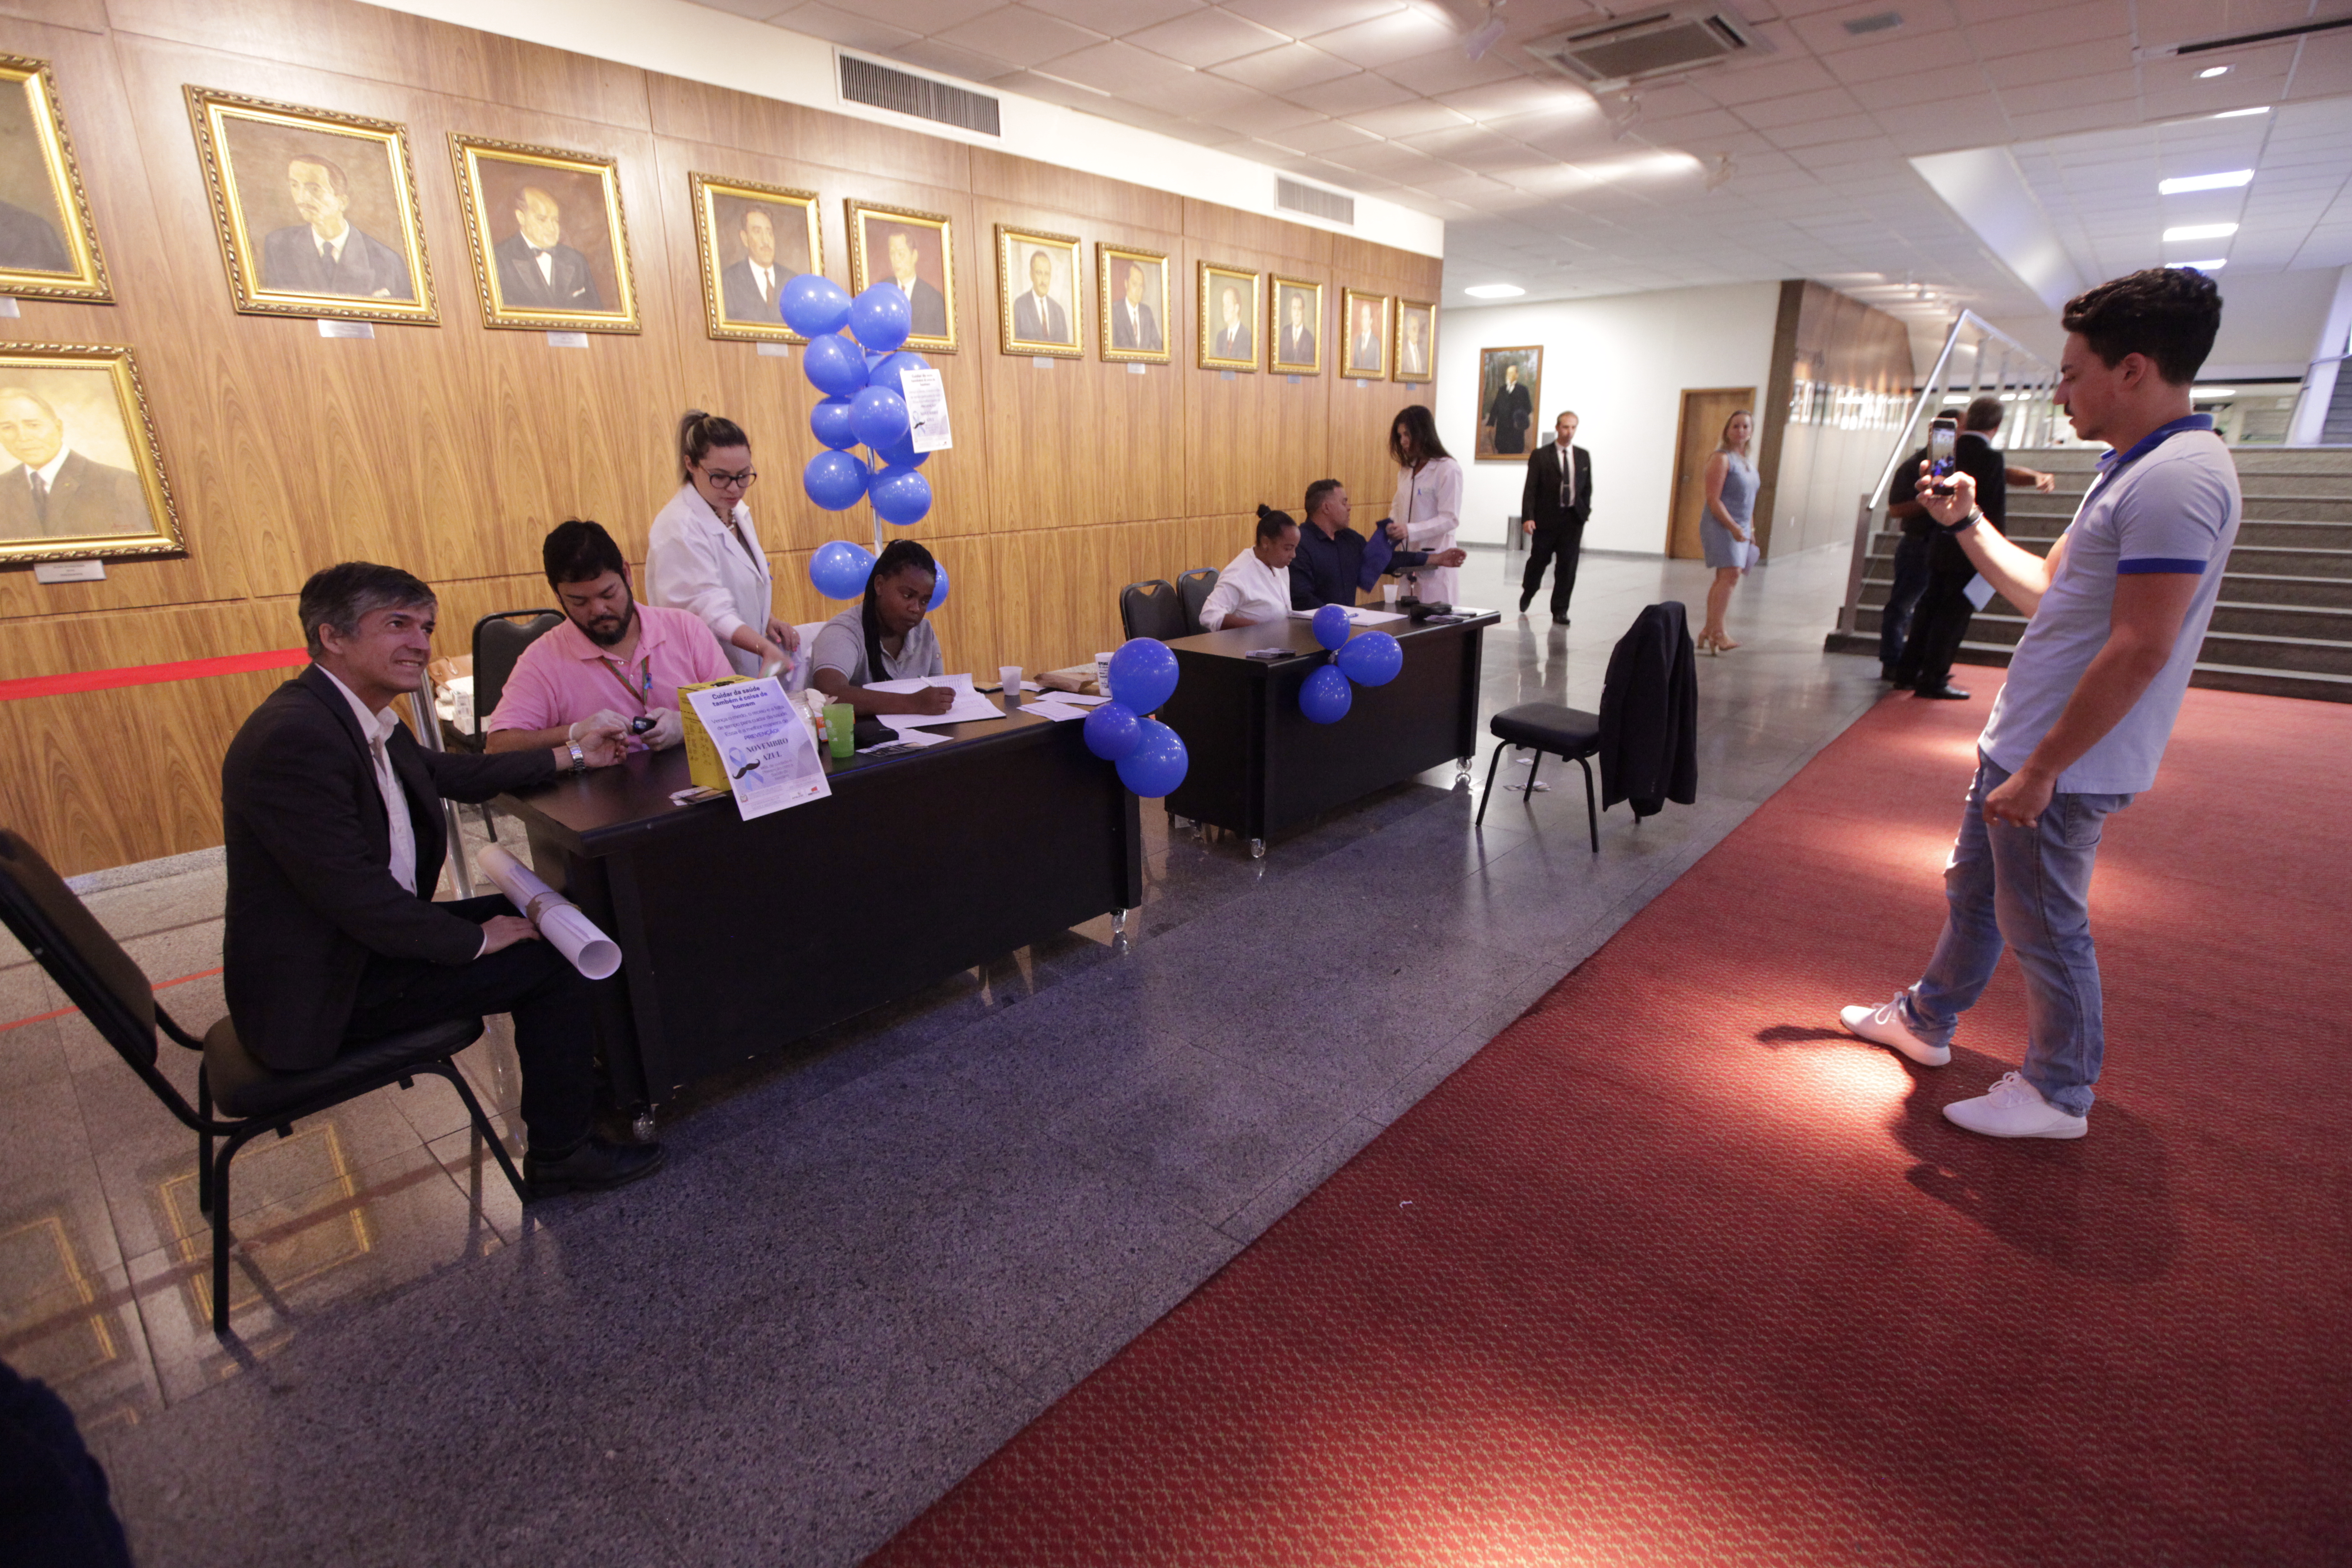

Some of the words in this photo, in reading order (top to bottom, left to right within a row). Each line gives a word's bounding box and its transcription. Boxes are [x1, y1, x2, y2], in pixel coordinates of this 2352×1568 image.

[712, 698, 738, 707] também
[744, 728, 779, 740] PREVENÇÃO!
[746, 738, 788, 753] NOVEMBRO
[763, 751, 782, 761] AZUL
